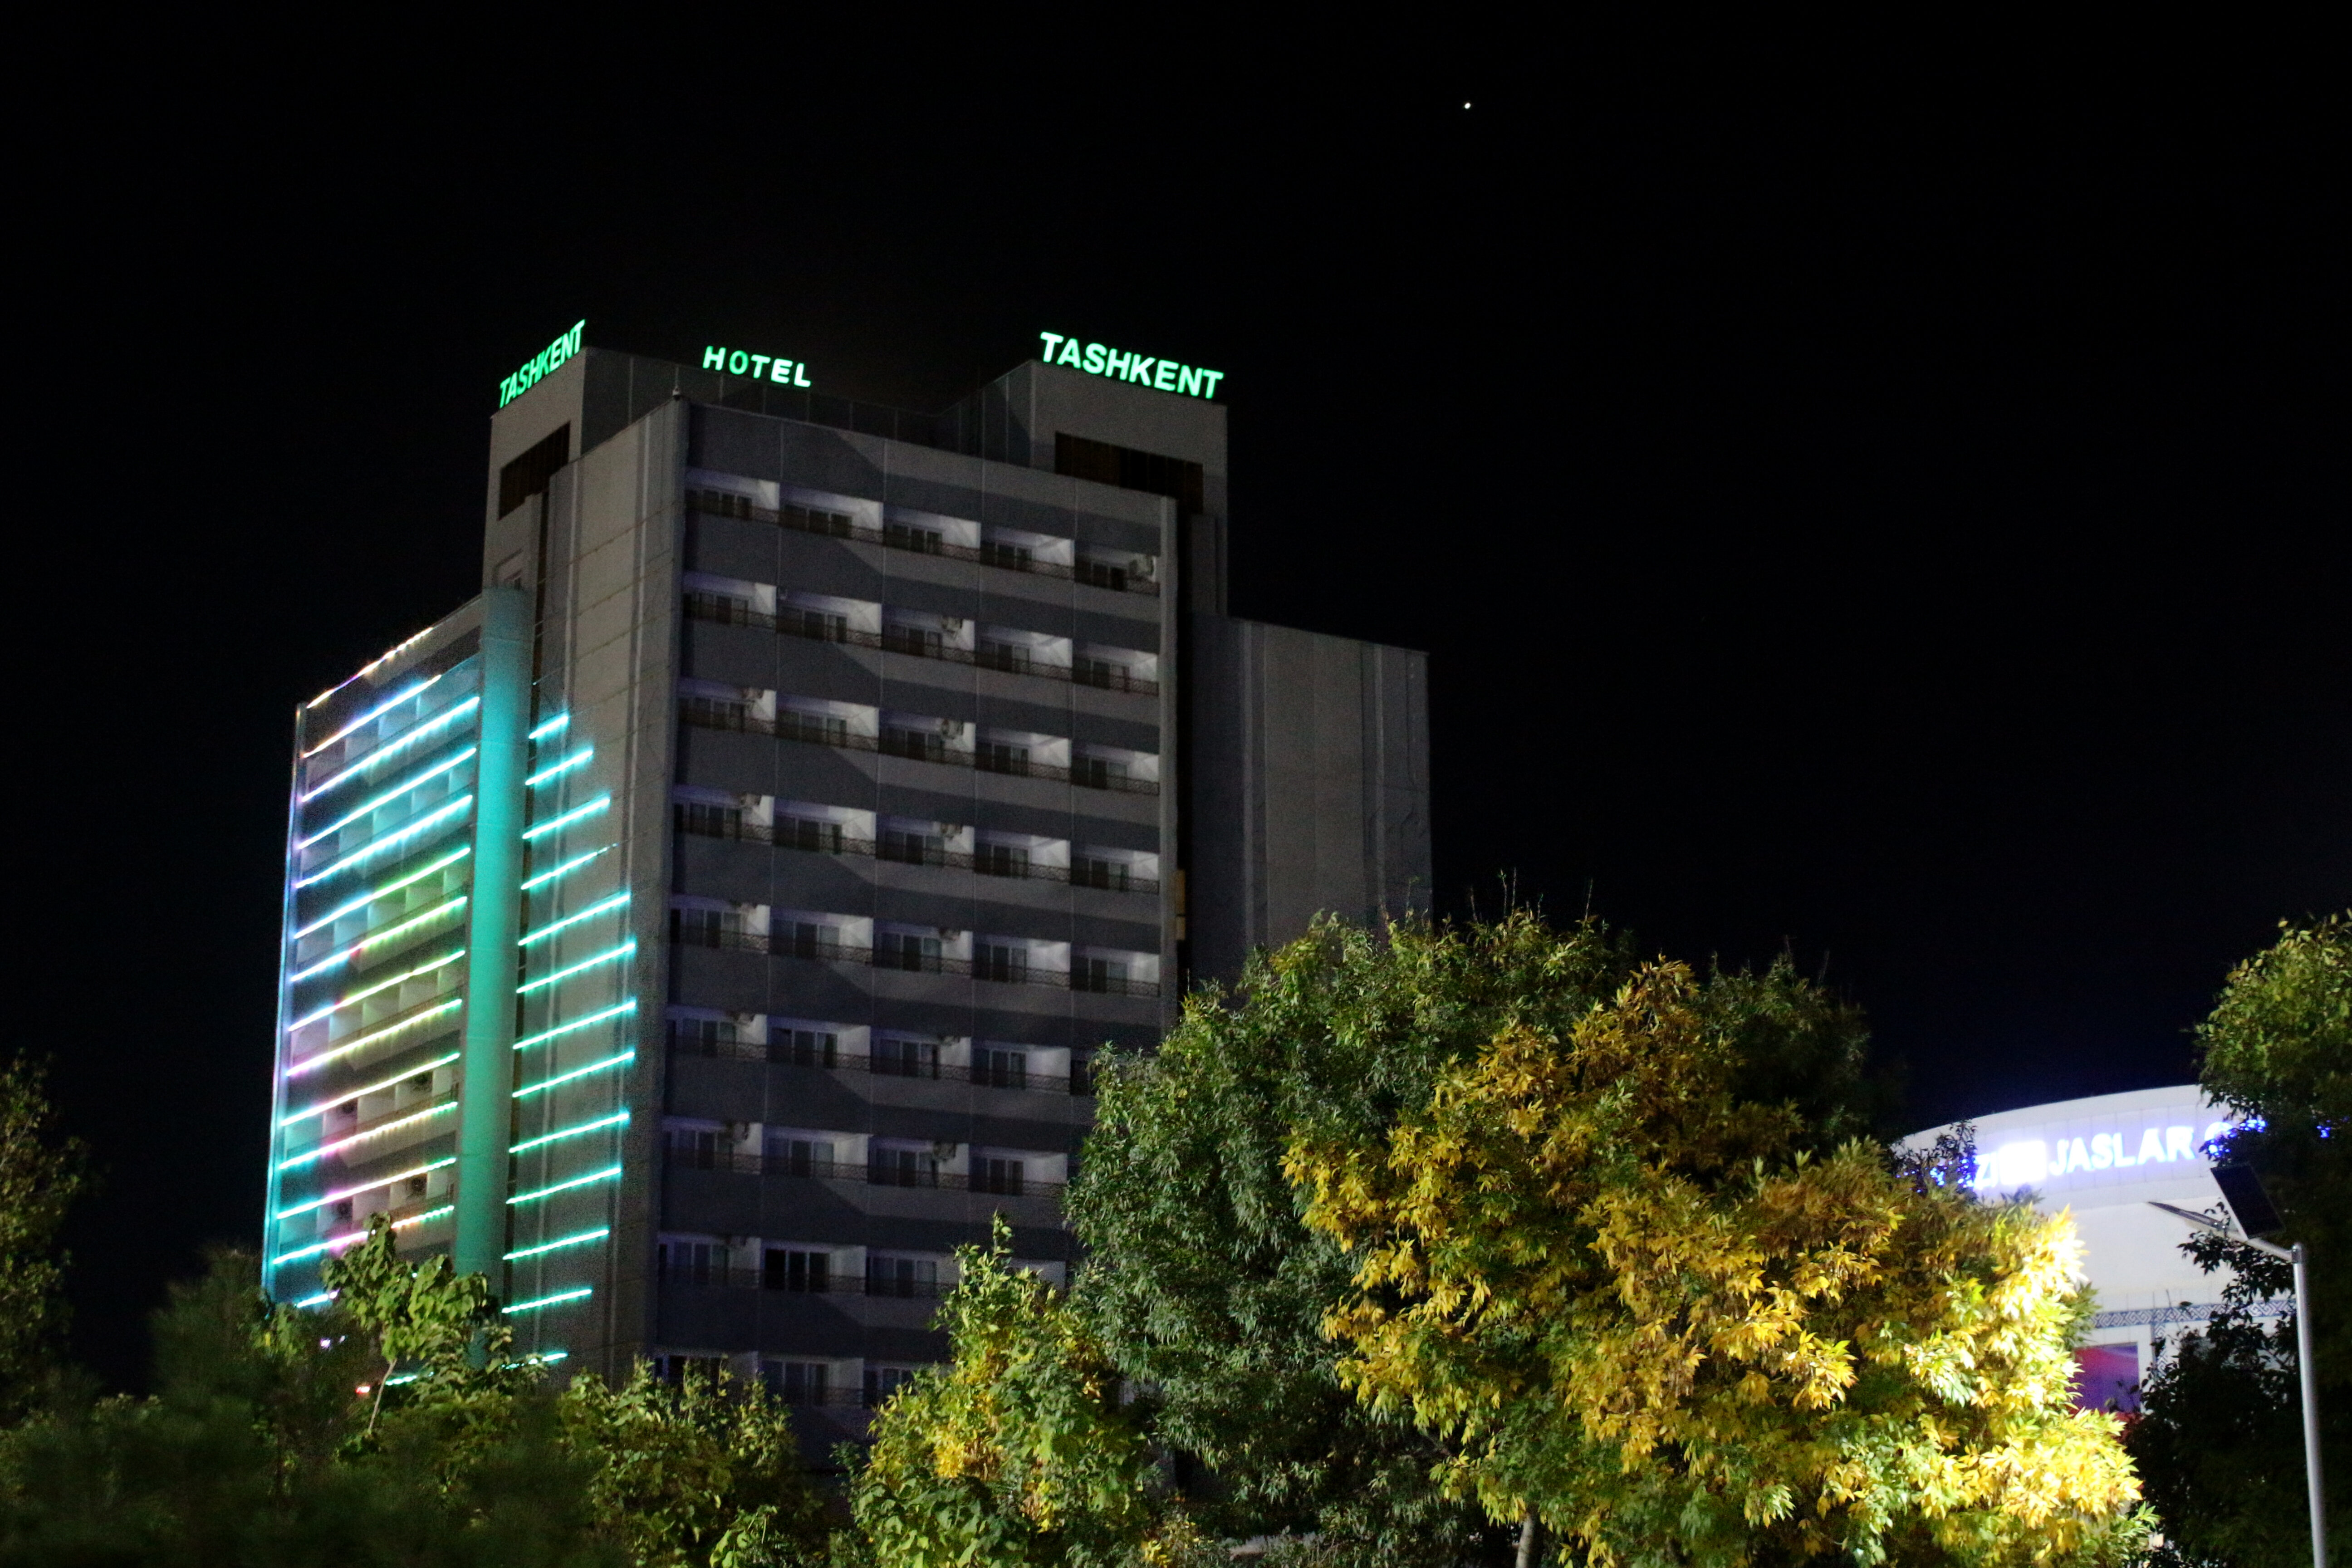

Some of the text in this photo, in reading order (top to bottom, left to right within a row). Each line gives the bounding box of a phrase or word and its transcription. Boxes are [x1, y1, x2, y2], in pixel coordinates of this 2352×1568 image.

[500, 318, 585, 408] TASHKENT
[702, 345, 811, 387] HOTEL
[1040, 331, 1224, 398] TASHKENT
